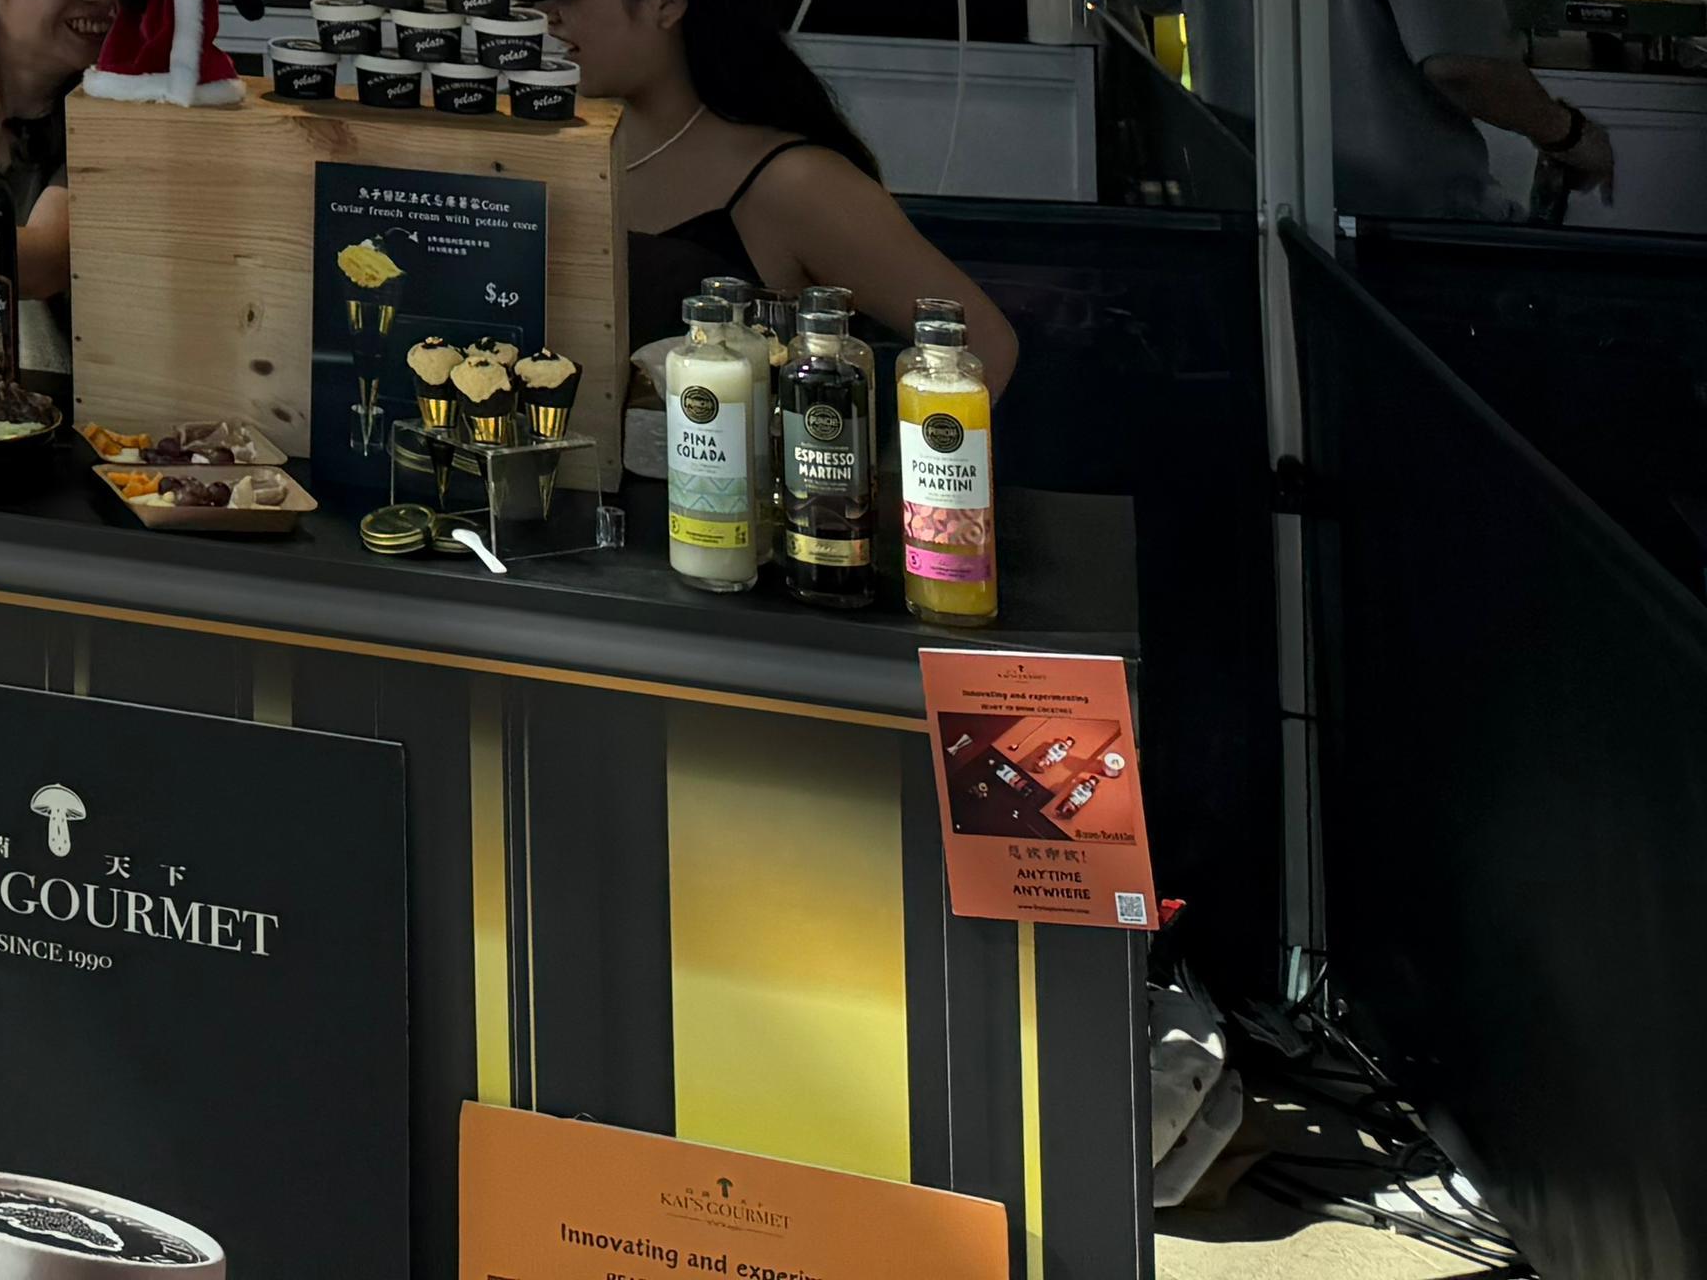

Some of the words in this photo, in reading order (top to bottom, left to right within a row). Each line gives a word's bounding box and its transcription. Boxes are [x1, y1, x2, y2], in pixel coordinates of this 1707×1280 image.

[330, 202, 364, 215] Caviar
[369, 207, 403, 218] french
[408, 212, 440, 222] cream
[445, 214, 470, 225] with
[475, 217, 508, 229] potato
[484, 282, 519, 307] $49
[683, 431, 716, 447] PINA
[676, 443, 726, 462] COLADA
[794, 447, 855, 465] ESPRESSO
[799, 462, 851, 480] MARTINI
[912, 460, 977, 478] PORNSTAR
[918, 477, 972, 492] MARTINI
[1017, 868, 1082, 882] ANYTIME
[1013, 885, 1091, 900] ANYWHERE
[0, 870, 279, 957] GOURMET
[68, 948, 112, 971] 1990
[660, 1192, 704, 1212] KAI'S
[706, 1201, 791, 1230] GOURMET
[560, 1222, 679, 1269] Innovating
[687, 1252, 727, 1275] and
